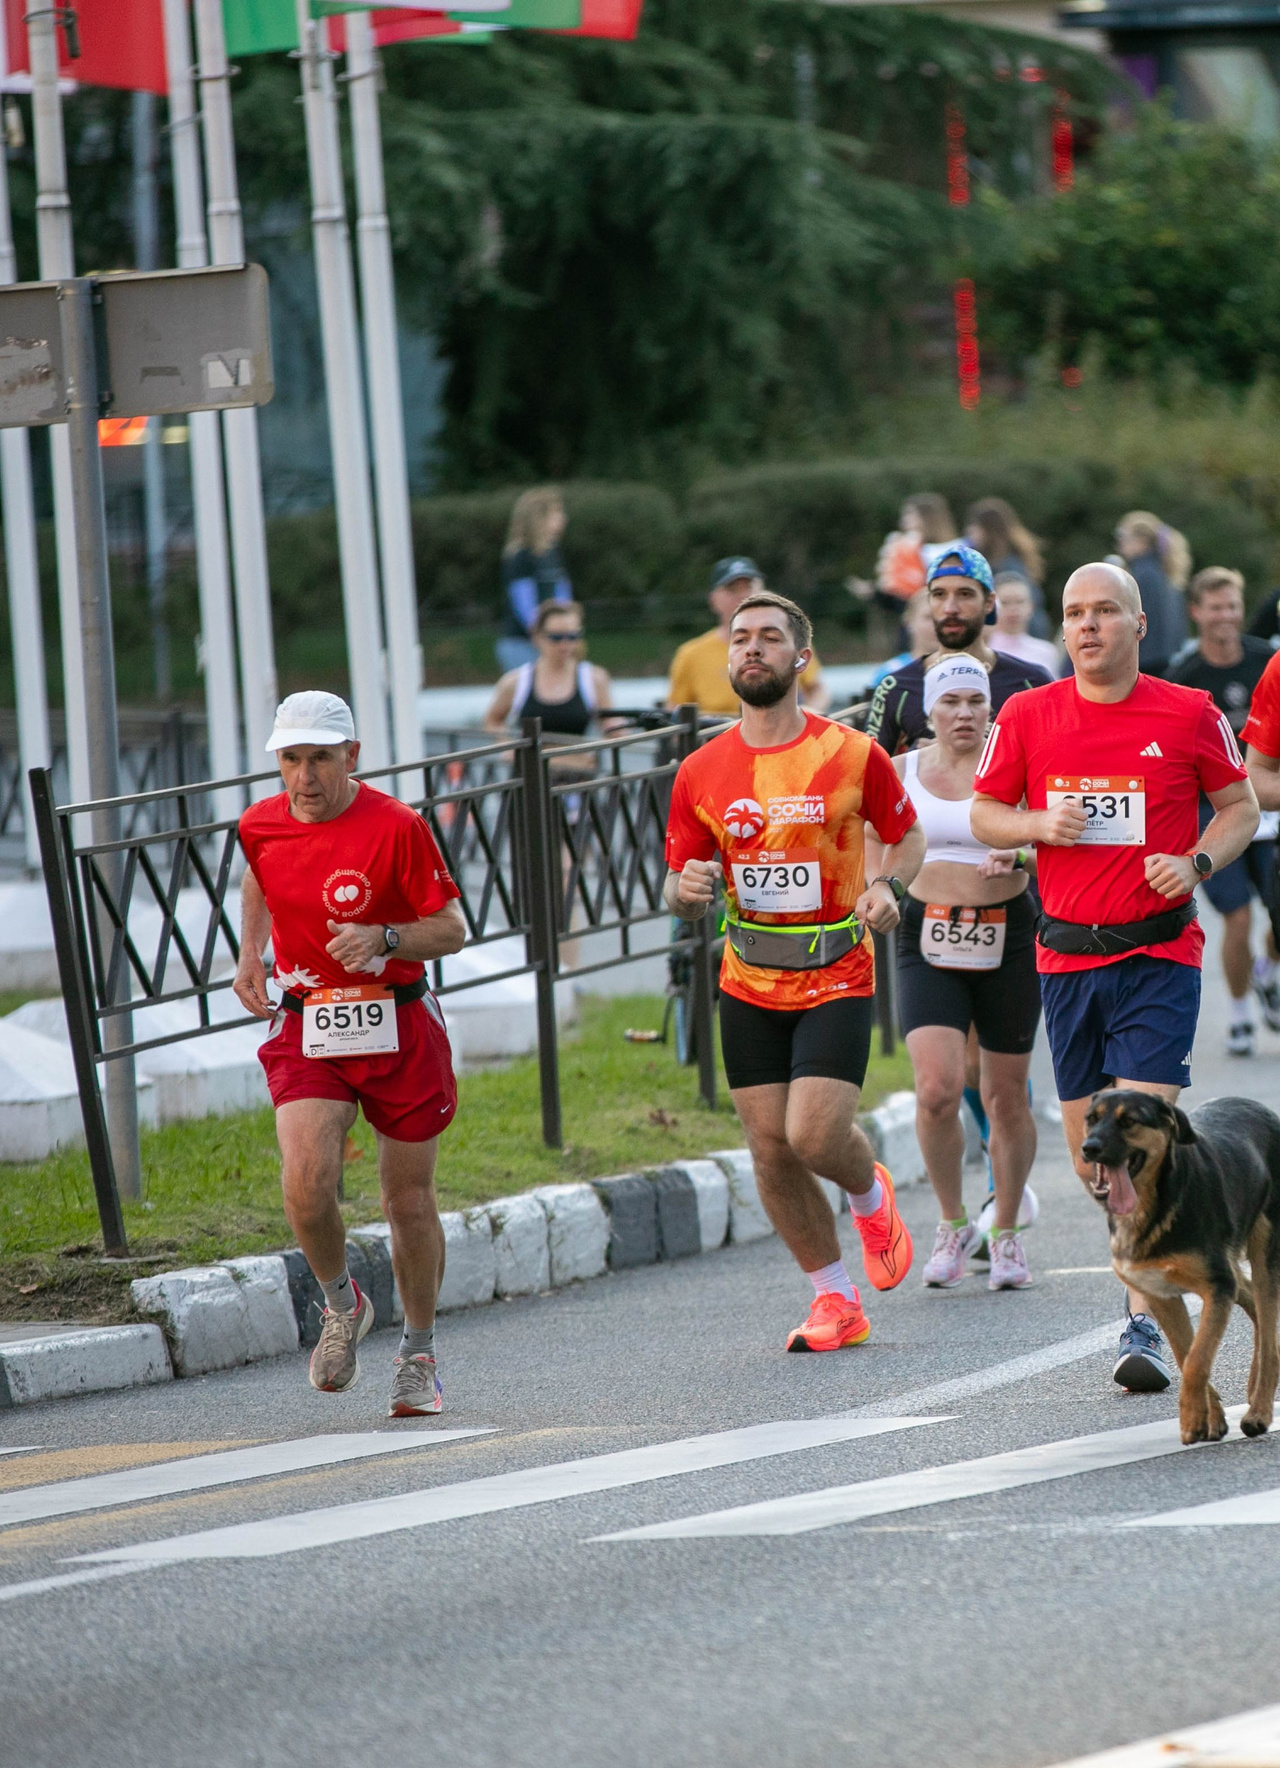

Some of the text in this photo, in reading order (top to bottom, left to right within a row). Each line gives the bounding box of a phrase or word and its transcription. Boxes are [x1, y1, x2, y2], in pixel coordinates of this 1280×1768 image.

[767, 795, 824, 804] СОВКОМБАНК
[767, 802, 825, 818] СОЧИ
[1063, 795, 1130, 818] 531
[769, 816, 825, 825] МАРАФОН
[743, 866, 809, 888] 6730
[321, 869, 372, 917] сообщество доноров крови
[931, 922, 996, 946] 6543
[315, 1003, 383, 1031] 6519
[328, 1030, 370, 1038] АЛЕКСАНДР
